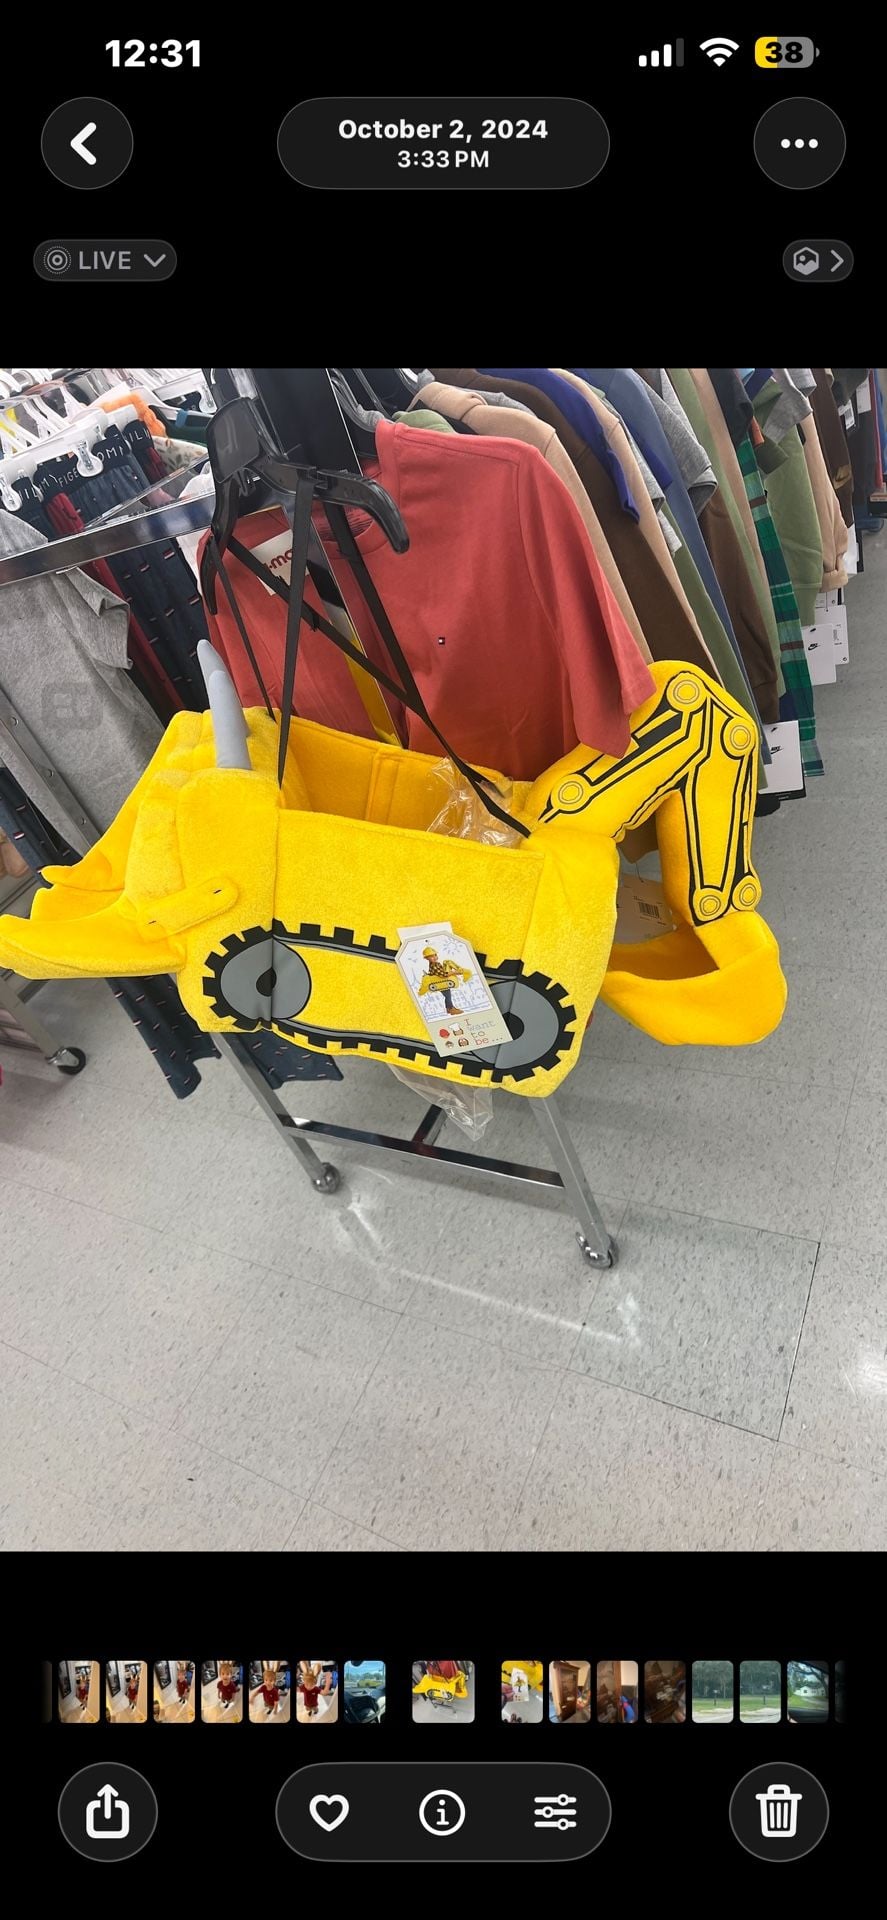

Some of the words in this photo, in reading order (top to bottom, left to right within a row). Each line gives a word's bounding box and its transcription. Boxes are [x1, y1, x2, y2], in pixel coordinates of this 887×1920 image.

[105, 38, 201, 68] 12:31
[765, 42, 804, 64] 38
[338, 118, 443, 140] October
[449, 119, 473, 144] 2,
[481, 119, 549, 140] 2024
[397, 149, 450, 169] 3:33
[455, 150, 489, 168] PM
[79, 250, 132, 270] LIVE
[464, 1018, 471, 1026] I
[466, 1020, 496, 1031] want
[471, 1031, 485, 1039] to
